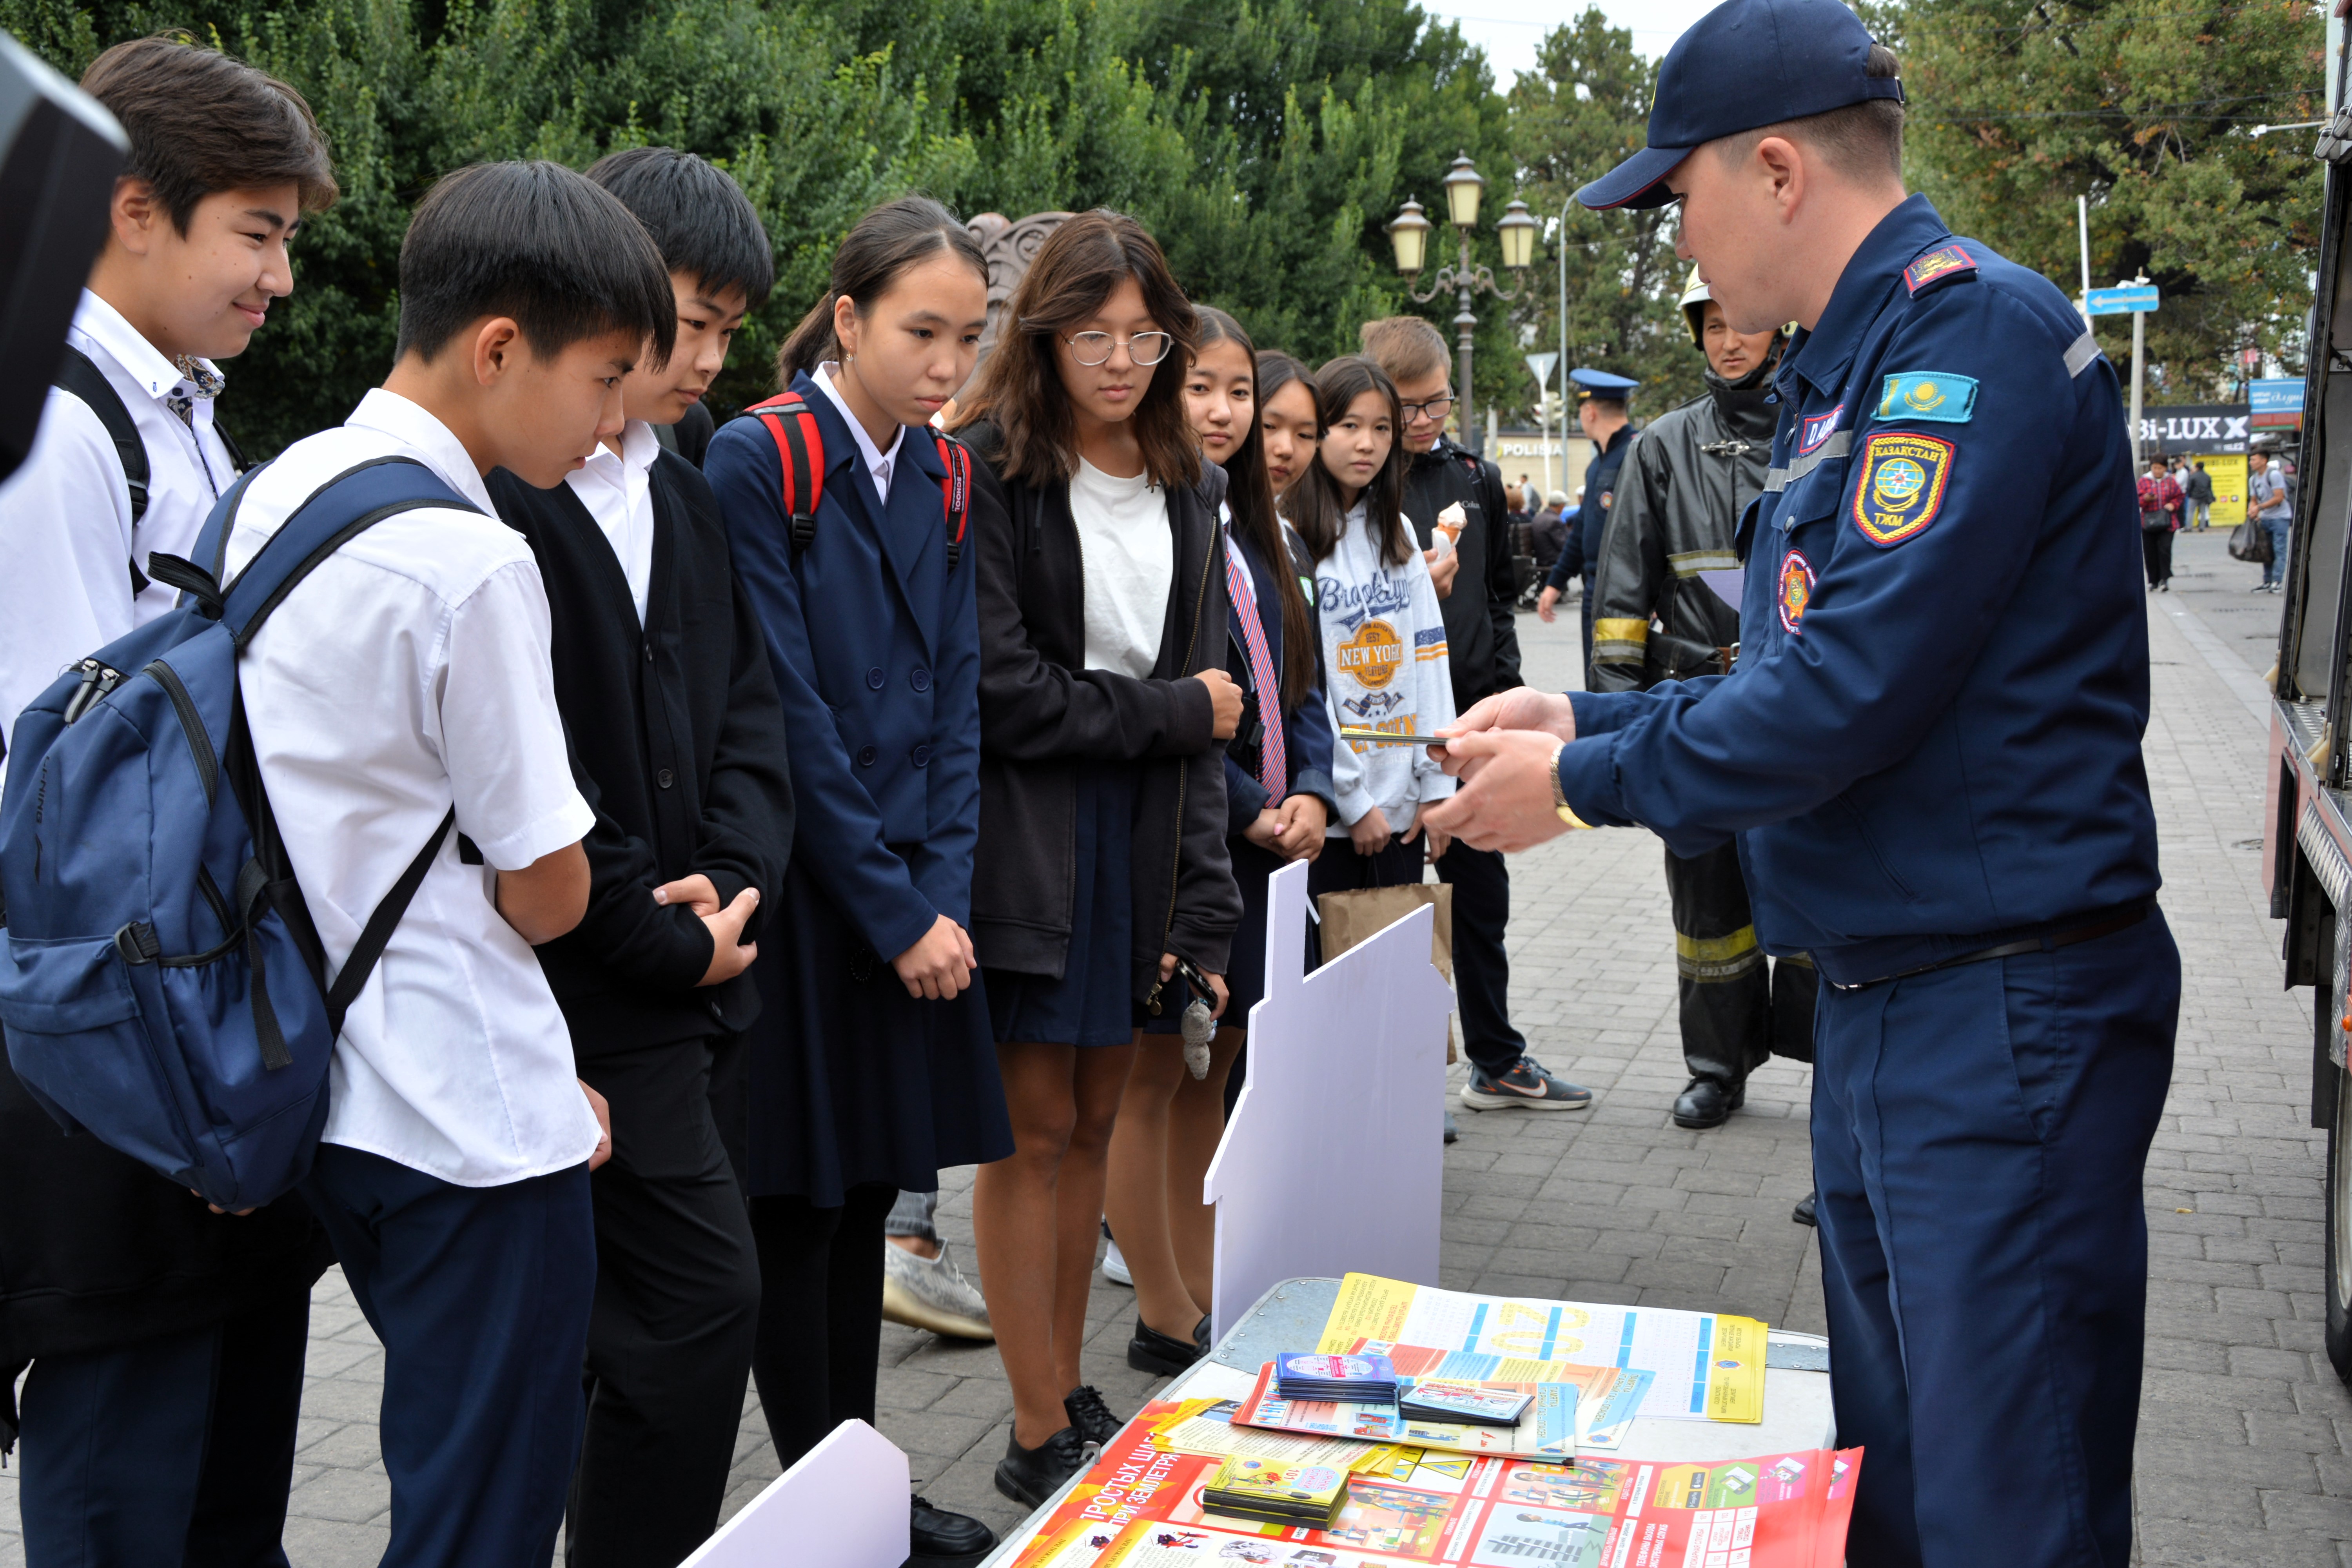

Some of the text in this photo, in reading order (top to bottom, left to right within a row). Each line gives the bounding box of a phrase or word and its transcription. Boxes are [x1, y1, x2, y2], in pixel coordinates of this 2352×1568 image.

[1503, 444, 1563, 456] POLISA
[1874, 445, 1940, 462] ҚАЗАҚСТАН
[1874, 512, 1904, 526] ТЖМ
[1317, 570, 1410, 613] Brooklyn
[1366, 632, 1381, 643] BEST
[1373, 623, 1396, 642] ADVENTURE
[1341, 644, 1401, 666] NEW YORK
[1365, 665, 1388, 677] FEATURE
[35, 755, 51, 825] LI-NING
[1383, 1305, 1398, 1325] ТЕЛЕФОНЫ
[1622, 1374, 1639, 1393] ПАМЯТКА
[1538, 1387, 1548, 1407] УГАРНЫЙ
[1549, 1387, 1558, 1407] ПАМЯТКА
[1593, 1404, 1612, 1423] ОПАСЕН!
[1537, 1420, 1546, 1438] ОПАСЕН!
[1283, 1468, 1296, 1480] 101
[1303, 1470, 1321, 1489] СПИЧКИ
[1624, 1477, 1634, 1488] ГОТОВЫ
[1079, 1461, 1146, 1521] ПРОСТЫХ
[1108, 1502, 1142, 1526] ПРИ
[1126, 1452, 1182, 1502] ЗЕМЛЕТРЯ
[1444, 1517, 1458, 1535] ПОКИНЬТЕ
[1054, 1539, 1066, 1547] ПРИ
[1122, 1538, 1132, 1547] ПРИ
[1600, 1527, 1619, 1567] ДЕРЖИТЕСЬ ПОДАЛЬШЕ
[1636, 1523, 1656, 1566] ТЕЛЕФОНЫ ВЫЗОВА
[1649, 1524, 1668, 1568] ЭКСТРЕННЫХ СЛУЖБ
[1036, 1548, 1058, 1563] ПОЖАРЕ
[1108, 1546, 1126, 1563] ПОЖАРЕ
